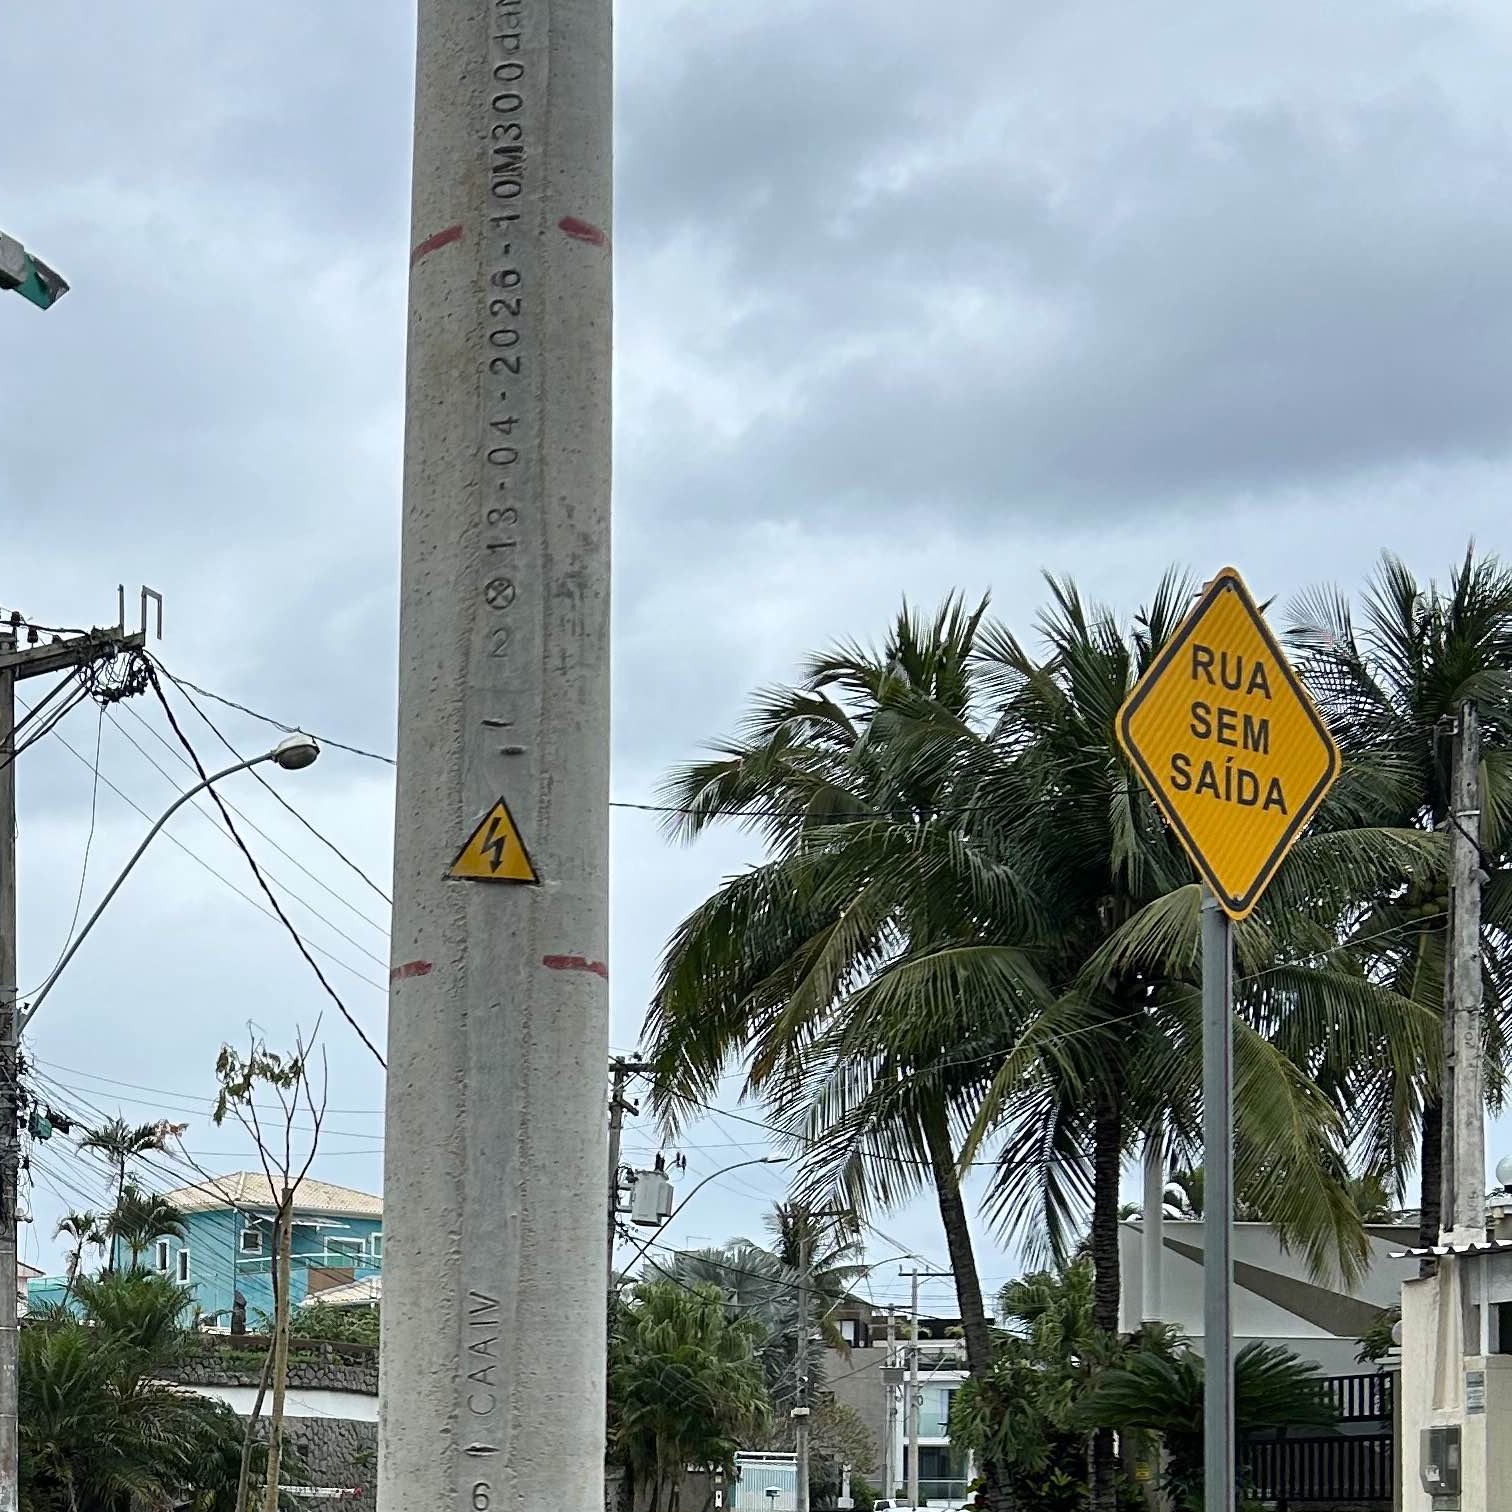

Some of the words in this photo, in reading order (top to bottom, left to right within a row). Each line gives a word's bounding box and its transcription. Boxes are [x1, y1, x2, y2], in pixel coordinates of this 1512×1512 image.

[1191, 643, 1273, 700] RUA
[1190, 701, 1270, 755] SEM
[1170, 752, 1288, 816] SAÍDA
